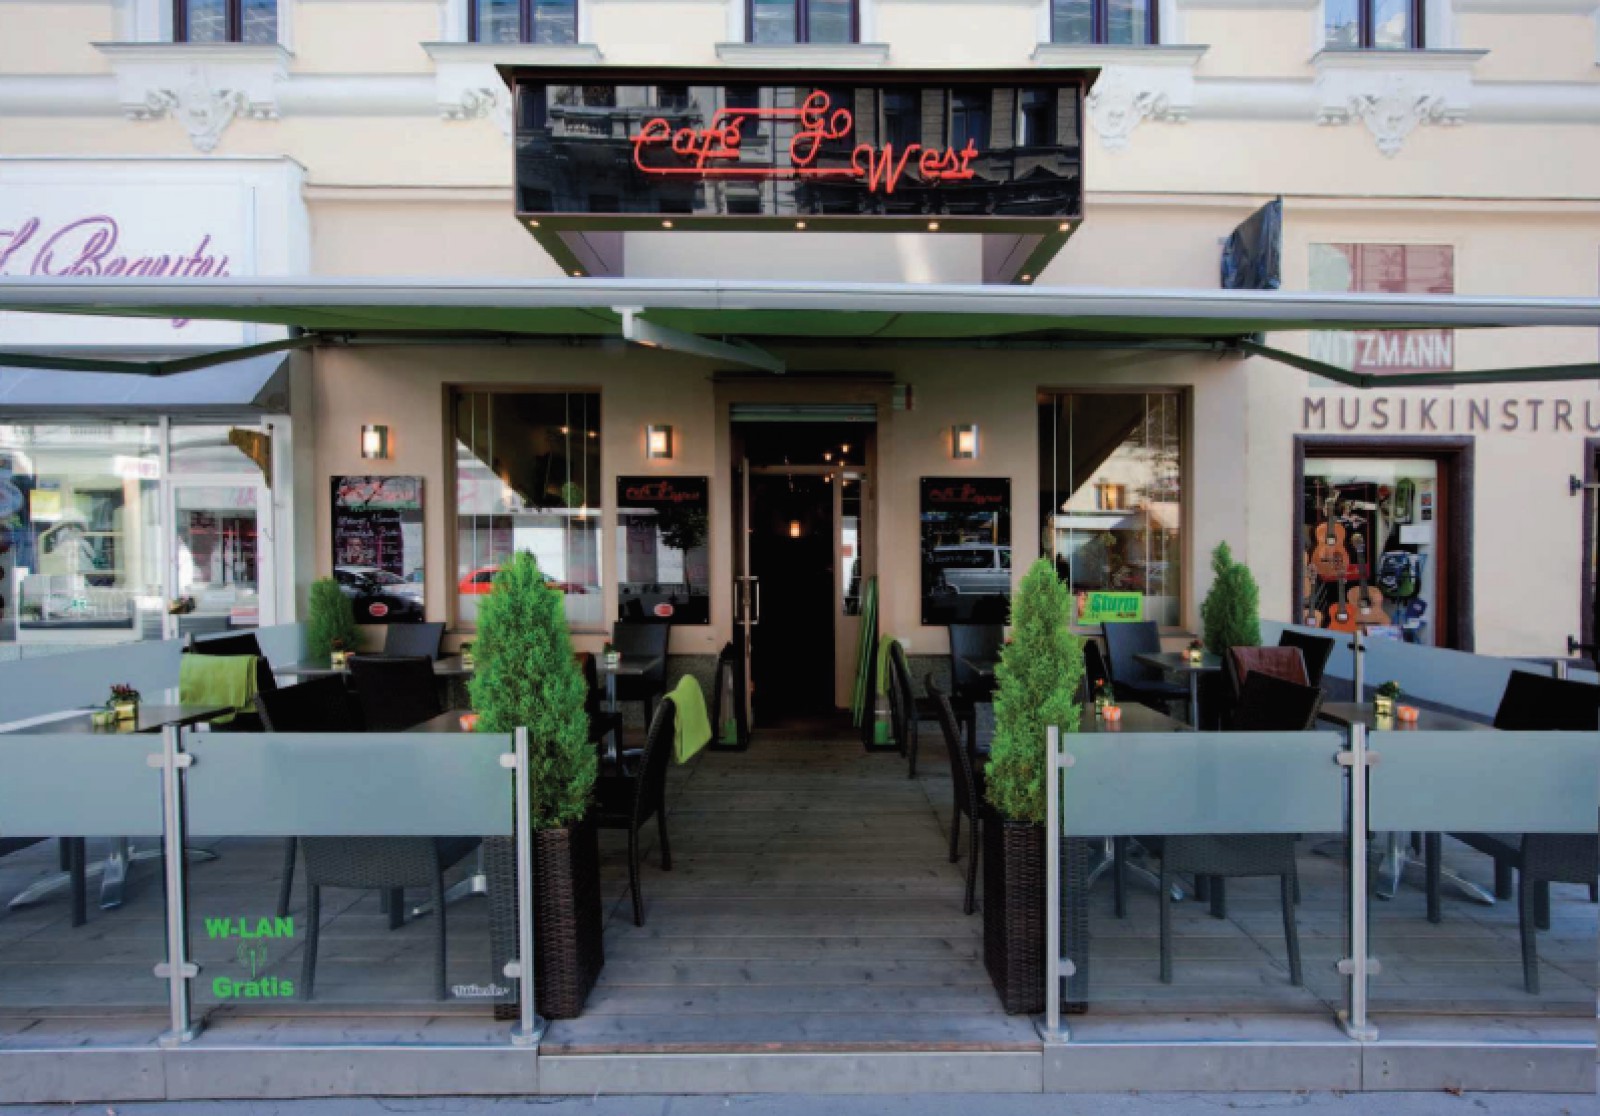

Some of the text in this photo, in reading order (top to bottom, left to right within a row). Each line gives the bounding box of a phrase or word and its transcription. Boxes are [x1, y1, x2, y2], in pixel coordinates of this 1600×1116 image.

[630, 90, 979, 194] Café Go West
[205, 917, 294, 939] W-LAN
[212, 976, 295, 999] Gratis
